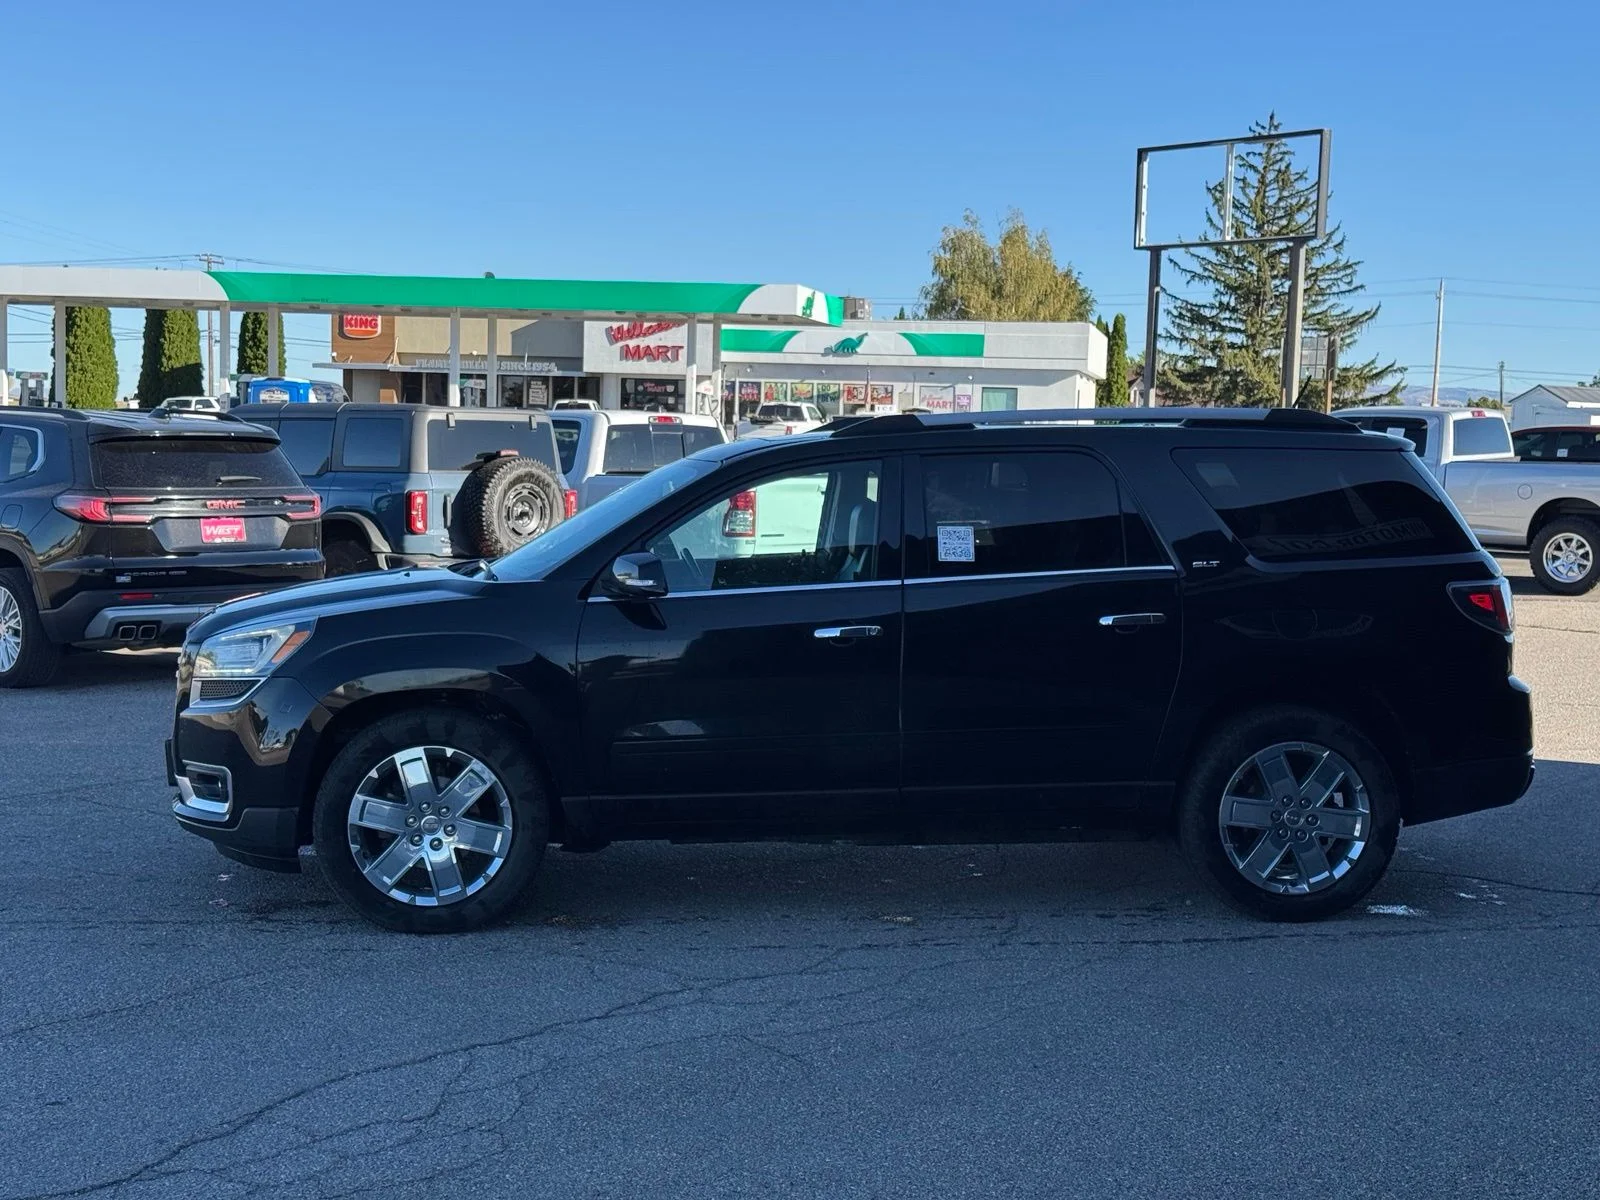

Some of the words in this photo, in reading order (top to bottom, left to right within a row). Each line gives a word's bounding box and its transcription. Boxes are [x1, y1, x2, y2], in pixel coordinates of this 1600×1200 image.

[345, 317, 378, 329] KING
[622, 344, 684, 362] MART
[501, 361, 531, 371] SINCE
[532, 362, 557, 372] 1954
[926, 400, 953, 409] MART
[207, 500, 246, 510] GMC
[204, 525, 240, 536] WEST
